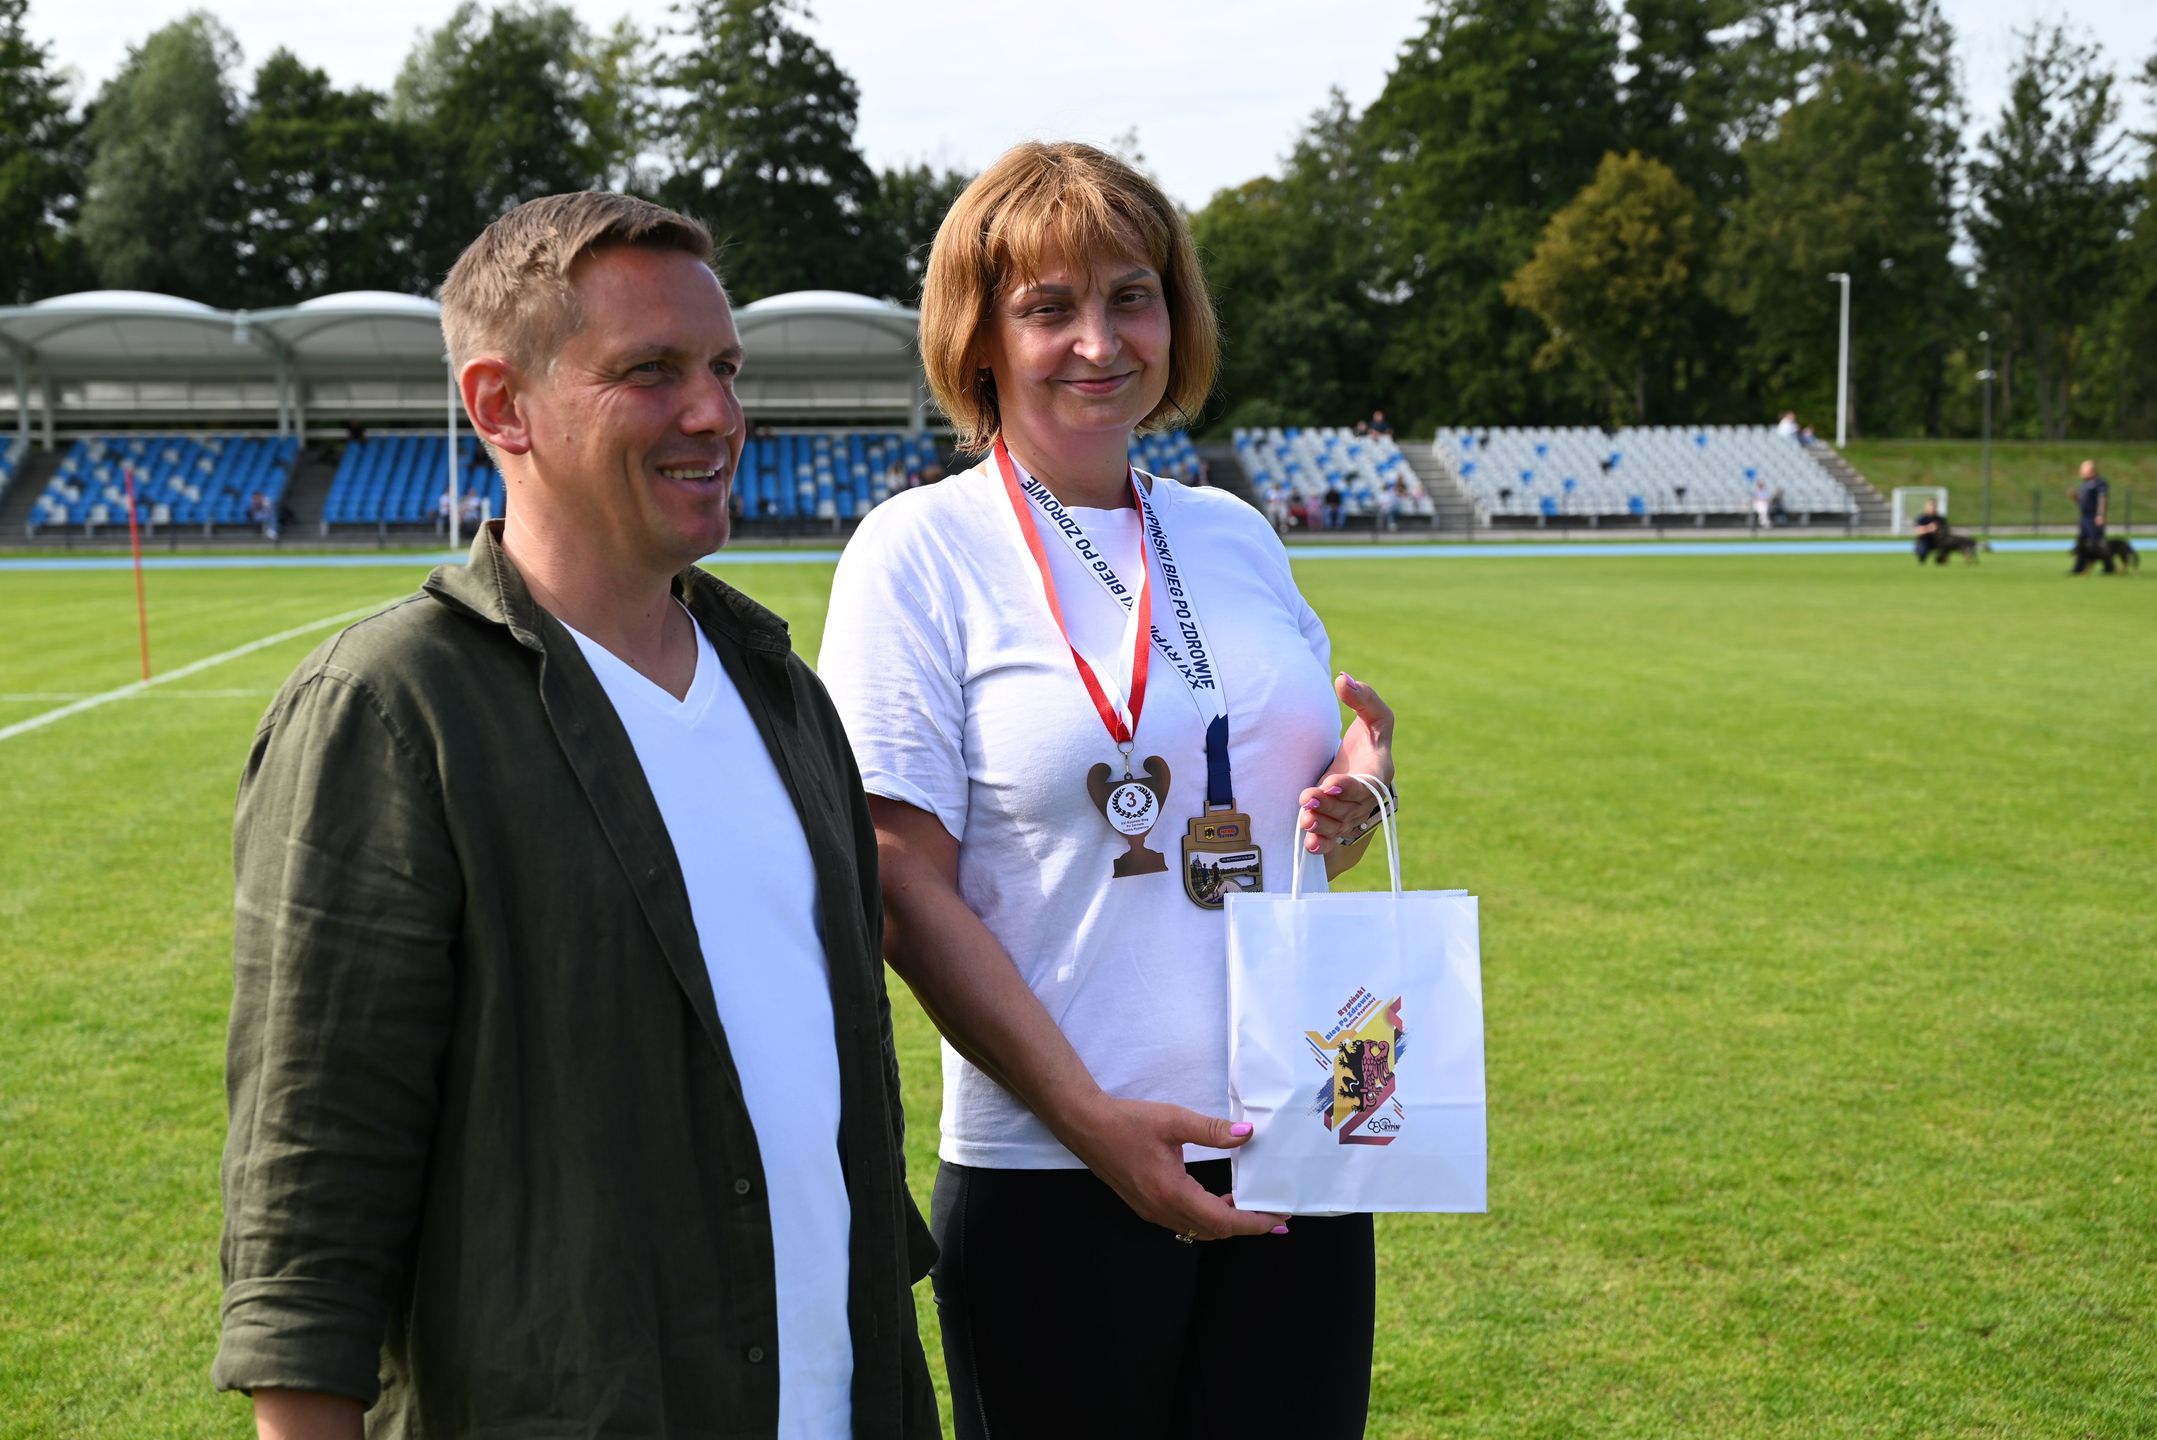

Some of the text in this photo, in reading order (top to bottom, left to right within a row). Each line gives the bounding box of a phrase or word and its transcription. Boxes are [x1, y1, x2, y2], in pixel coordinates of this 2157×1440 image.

[1020, 475, 1083, 539] ZDROWIE
[1075, 538, 1099, 560] PO
[1092, 561, 1127, 595] BIEG
[1162, 563, 1184, 598] BIEG
[1172, 599, 1191, 618] PO
[1177, 664, 1204, 690] XXI
[1125, 791, 1137, 808] 3
[1339, 1017, 1348, 1026] Po
[1347, 992, 1372, 1018] Zdrowie
